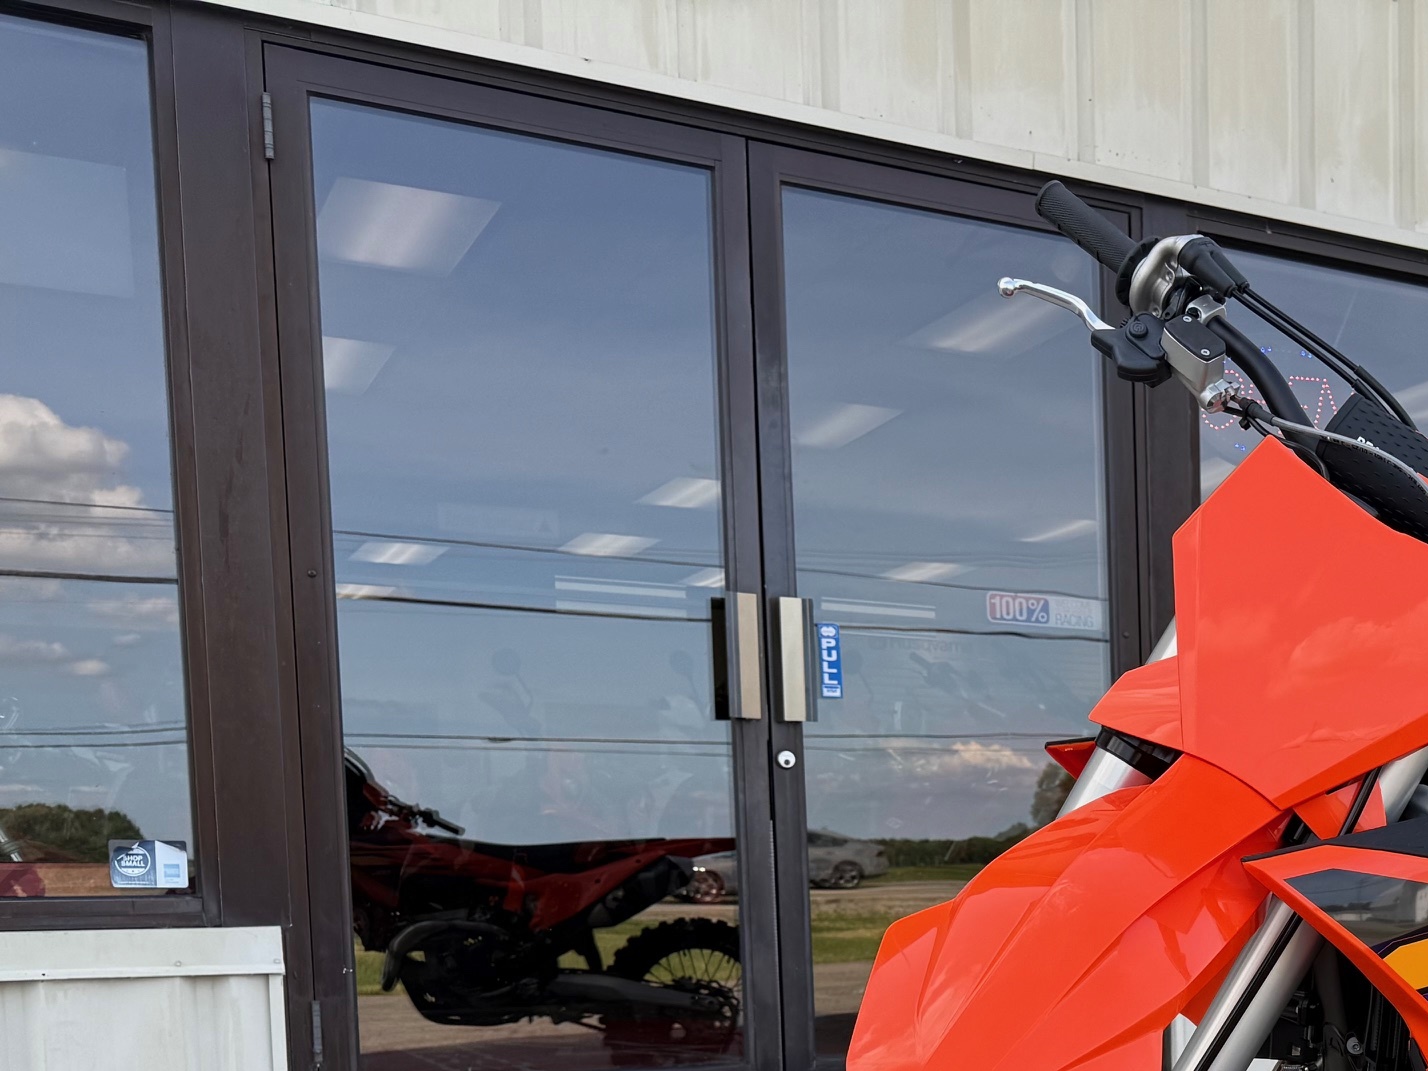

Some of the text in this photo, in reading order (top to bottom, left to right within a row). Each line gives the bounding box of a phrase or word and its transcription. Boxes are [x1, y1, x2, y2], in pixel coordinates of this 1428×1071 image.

[989, 595, 1048, 623] 100%
[1054, 613, 1094, 628] RACING
[821, 638, 839, 685] PULL
